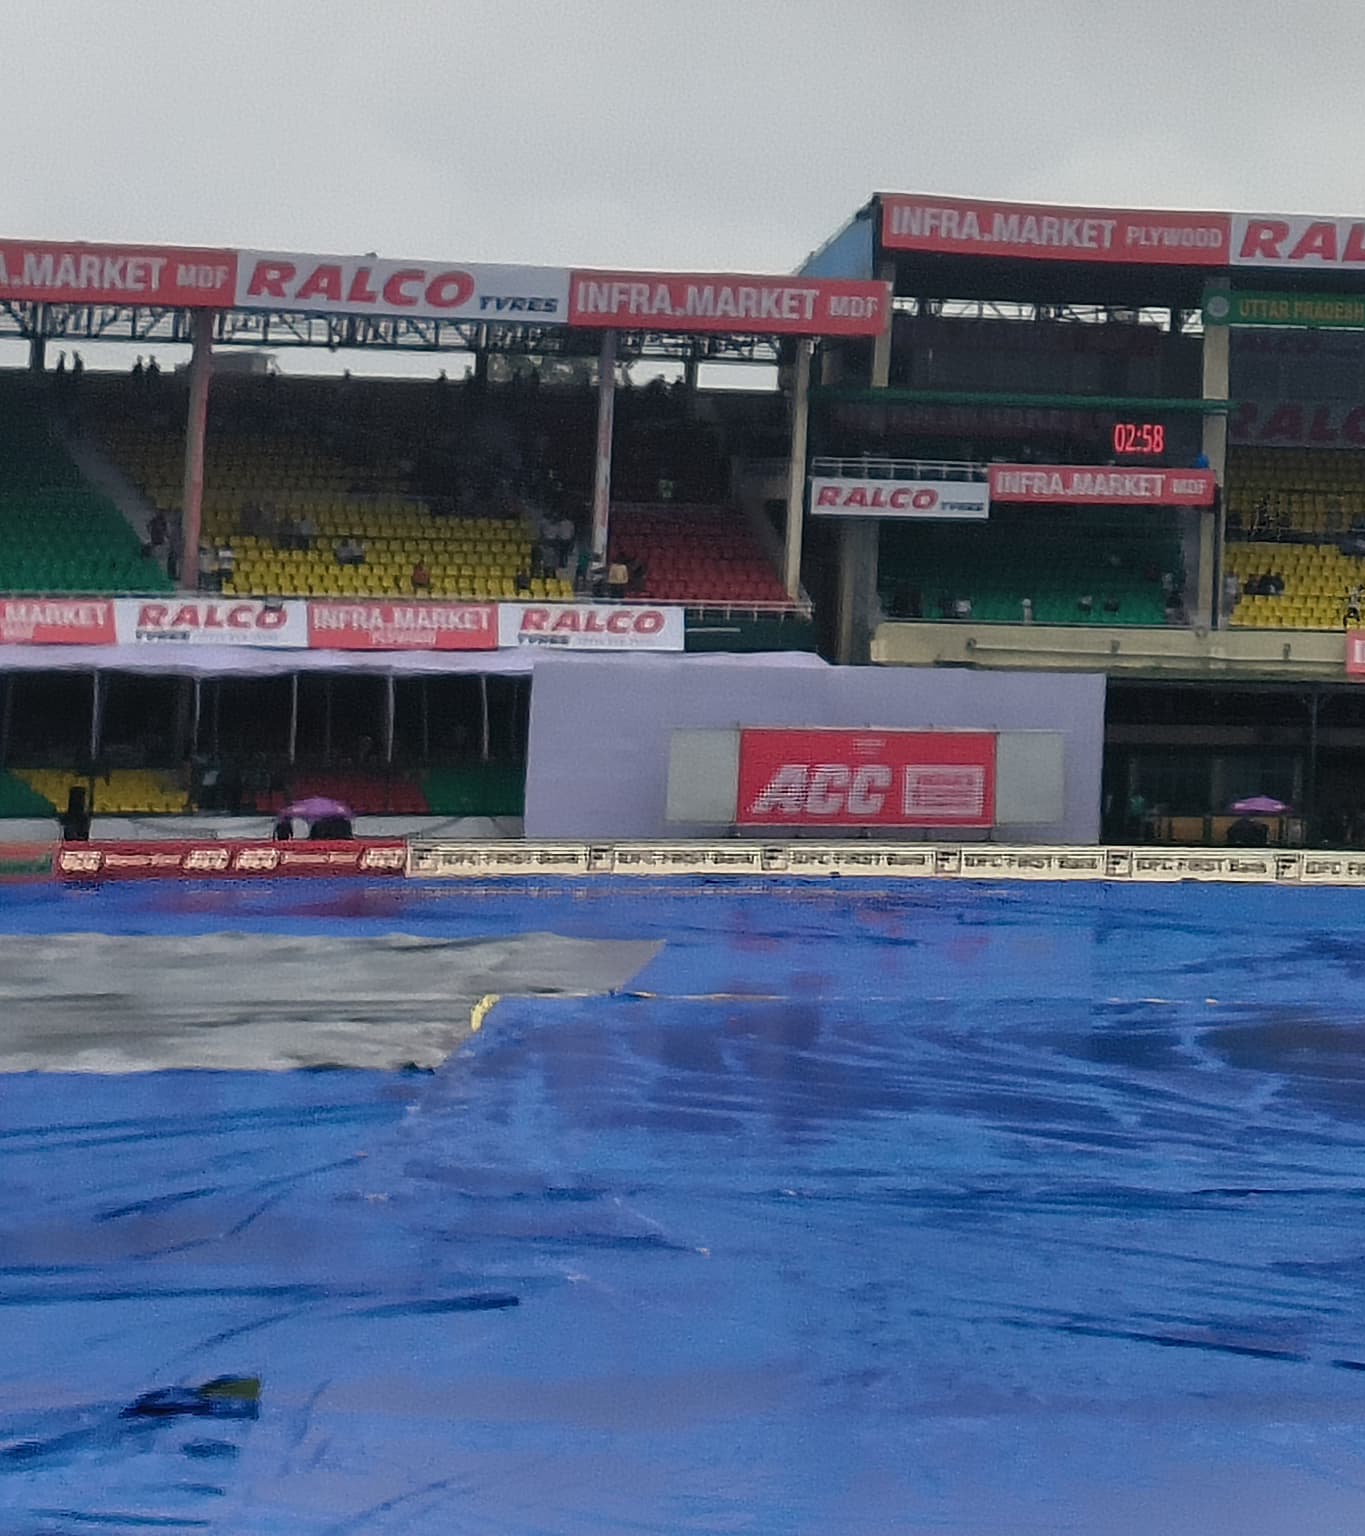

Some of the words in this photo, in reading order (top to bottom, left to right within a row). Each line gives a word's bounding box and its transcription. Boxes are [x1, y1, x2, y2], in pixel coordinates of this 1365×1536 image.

[891, 206, 1116, 248] INFRA.MARKET
[1126, 225, 1222, 248] PLYWOOD
[176, 264, 229, 289] MDF
[247, 260, 474, 308] RALCO
[480, 296, 559, 313] TYRES
[577, 281, 819, 320] INFRA.MARKET
[829, 296, 878, 319] MDF
[1240, 300, 1289, 317] UTTAR
[1114, 423, 1165, 453] 02:58
[816, 486, 938, 510] RALCO
[995, 470, 1166, 498] INFRA.MARKET
[137, 604, 288, 629] RALCO
[520, 607, 665, 634] RALCO
[749, 763, 893, 814] ACC
